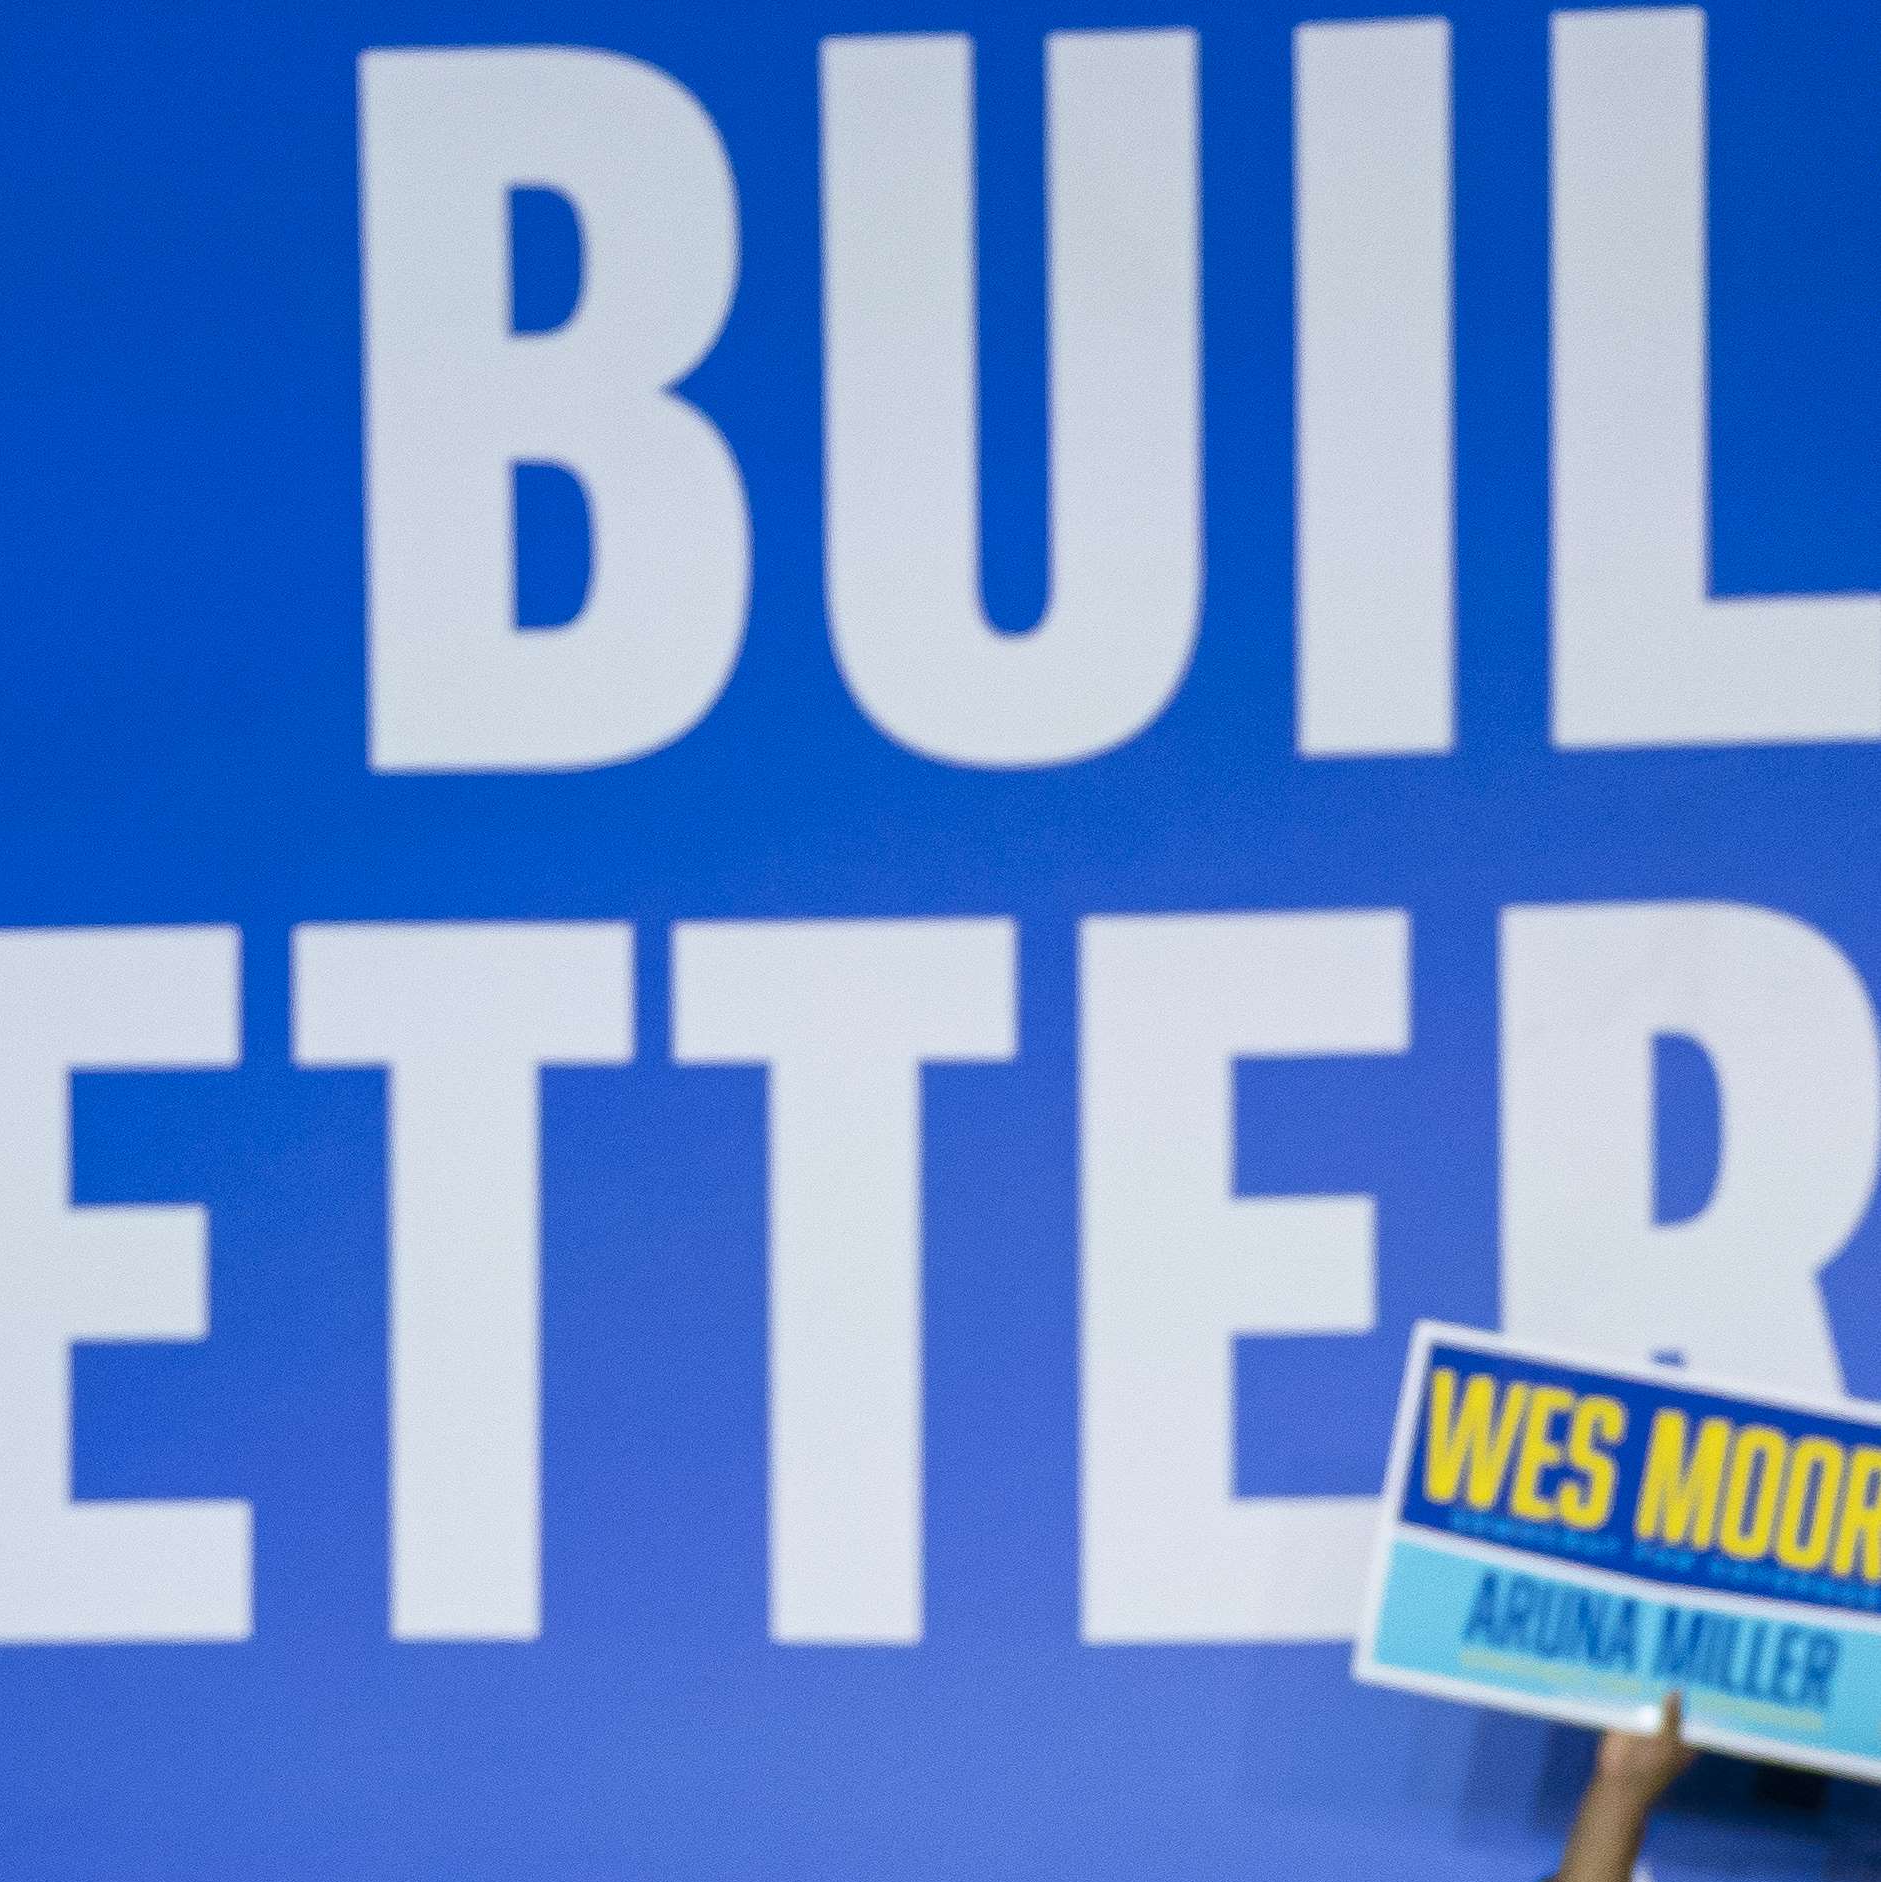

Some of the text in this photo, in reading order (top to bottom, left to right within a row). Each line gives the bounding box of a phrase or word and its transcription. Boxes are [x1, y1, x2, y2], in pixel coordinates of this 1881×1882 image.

[355, 8, 1881, 775] BUIL
[1423, 1368, 1627, 1530] WES
[1459, 1570, 1639, 1674] ARUNA
[1649, 1604, 1843, 1710] MILLER
